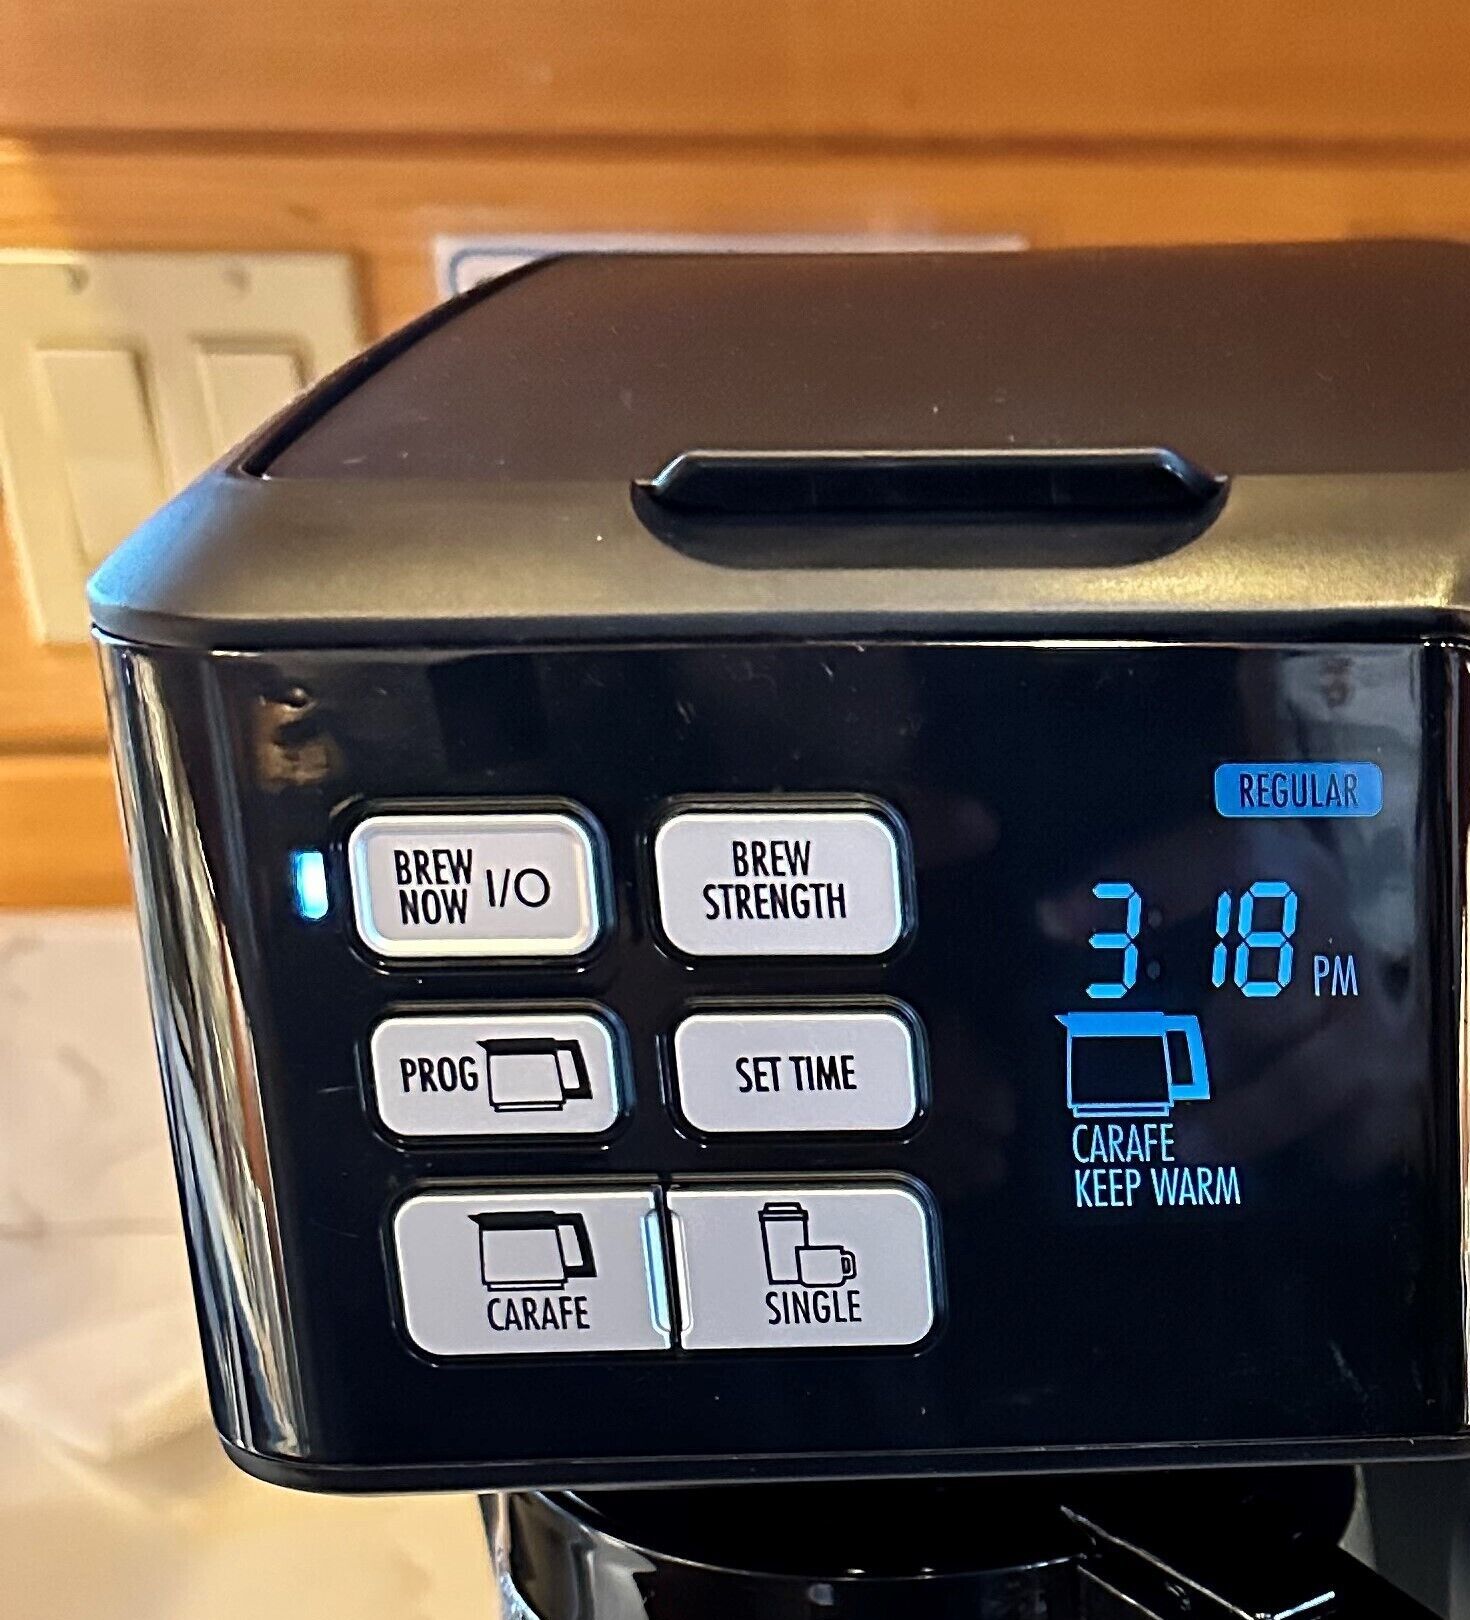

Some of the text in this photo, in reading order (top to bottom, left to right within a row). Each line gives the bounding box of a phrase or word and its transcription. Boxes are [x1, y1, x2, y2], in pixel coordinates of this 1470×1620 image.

[1240, 774, 1358, 808] REGULAR
[395, 850, 474, 886] BREW
[731, 840, 811, 876] BREW
[400, 890, 470, 925] NOW
[704, 884, 848, 921] STRENGTH
[1314, 955, 1359, 997] PM
[400, 1058, 480, 1093] PROG
[736, 1055, 858, 1093] SET TIME
[1073, 1124, 1175, 1163] CARAFE
[1076, 1167, 1241, 1208] KEEP WARM
[487, 1296, 591, 1331] CARAFE
[766, 1291, 862, 1324] SINGLE
